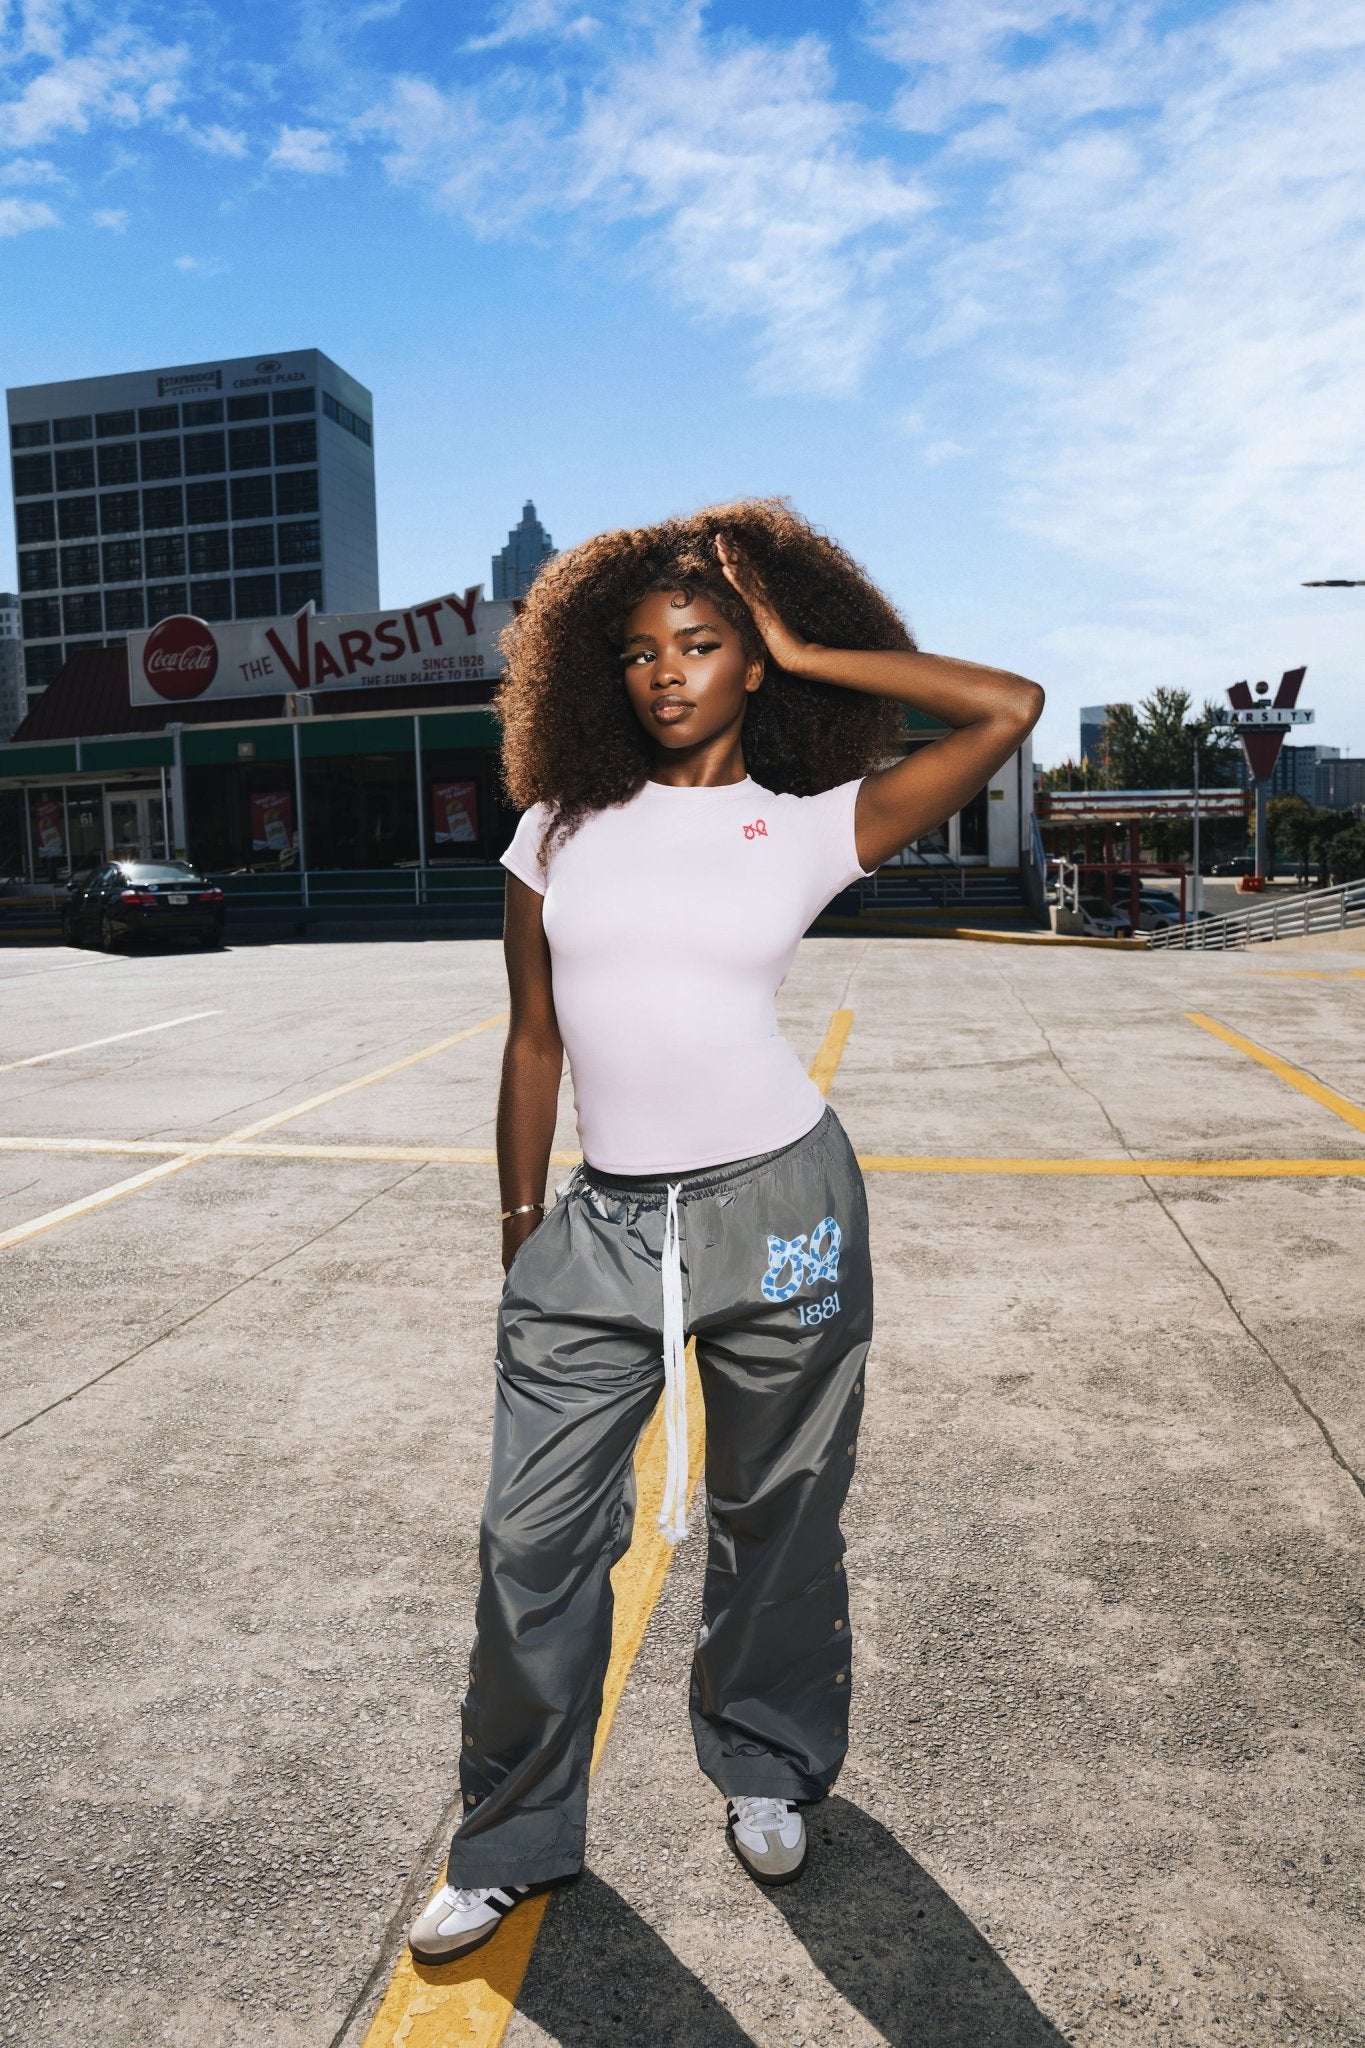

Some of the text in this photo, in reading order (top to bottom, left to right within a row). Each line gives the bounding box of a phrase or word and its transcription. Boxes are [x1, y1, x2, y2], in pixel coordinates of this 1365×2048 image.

[275, 371, 306, 383] PLAZA
[239, 588, 479, 689] THE VARSITY
[147, 644, 213, 674] Coca-Cola
[422, 655, 484, 670] SINCE 1928
[361, 668, 485, 686] THE FUN PLACE TO EAT
[1215, 712, 1312, 722] VARSITY
[80, 812, 93, 825] 61
[797, 1291, 842, 1325] 1881
